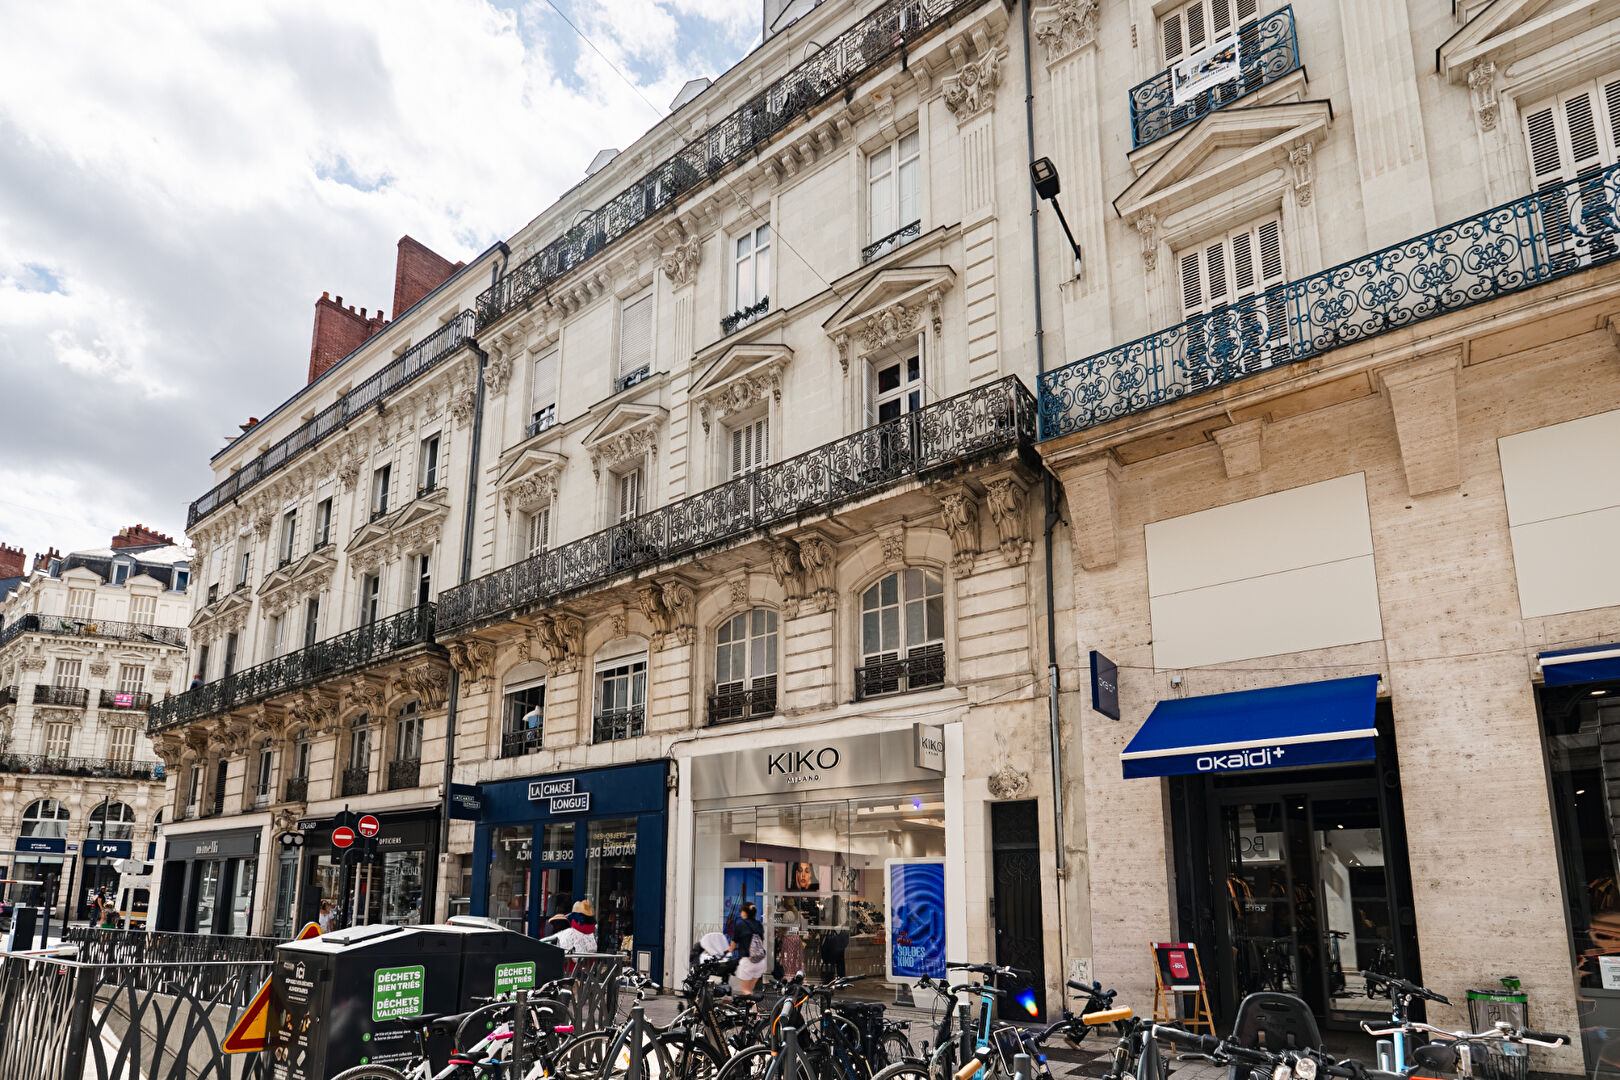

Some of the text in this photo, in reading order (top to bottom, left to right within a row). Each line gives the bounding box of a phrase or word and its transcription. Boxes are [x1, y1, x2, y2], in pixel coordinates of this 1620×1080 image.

[768, 747, 840, 775] KIKO
[531, 782, 571, 796] LA CHAISE
[552, 797, 587, 810] LONGUE
[897, 946, 926, 958] SOLDES
[897, 956, 914, 968] KIKO
[378, 970, 421, 983] DÉCHETS
[498, 966, 533, 977] DÉCHETS
[377, 980, 421, 993] BIEN TRIÉS
[497, 975, 533, 986] BIEN TRIÉS
[376, 996, 420, 1010] DÉCHETS
[376, 1005, 419, 1018] VALORISÉS
